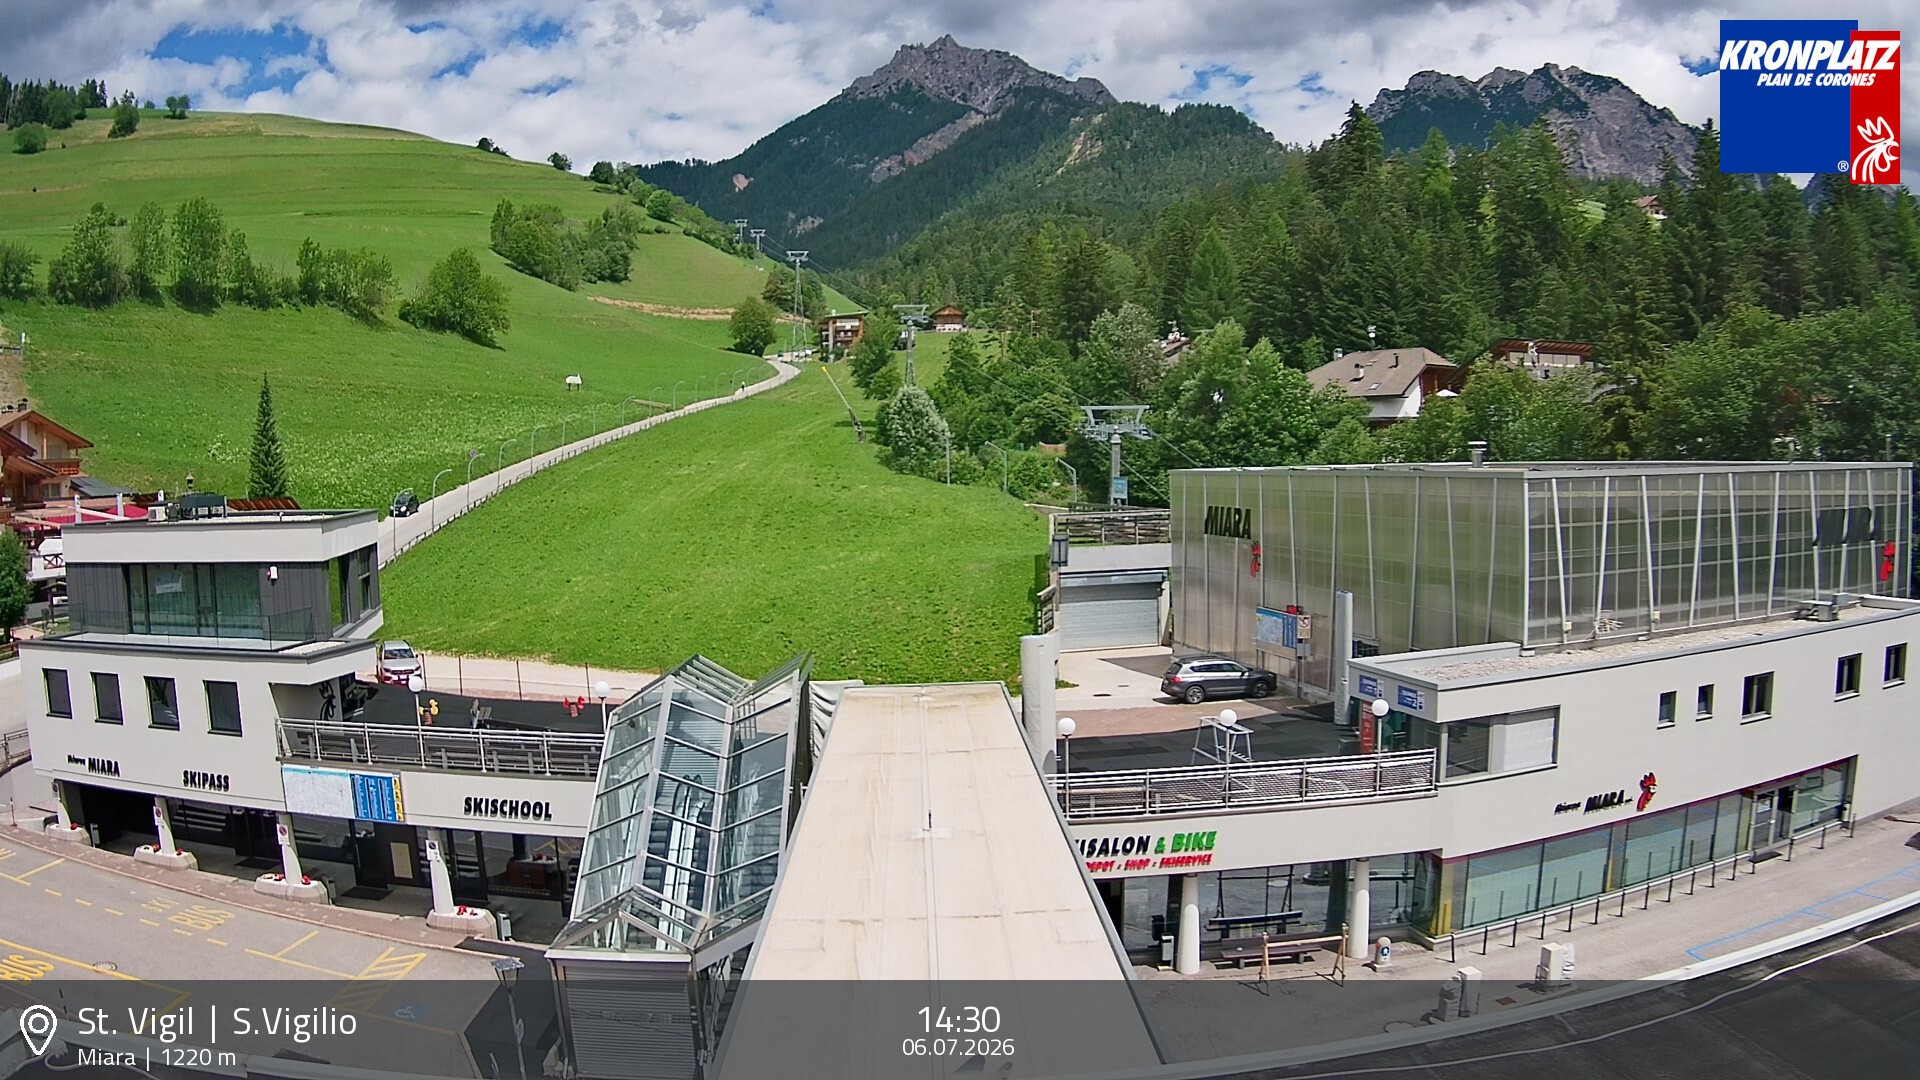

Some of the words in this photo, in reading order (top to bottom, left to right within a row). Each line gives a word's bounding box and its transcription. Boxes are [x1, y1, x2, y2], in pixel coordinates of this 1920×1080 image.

[1204, 506, 1252, 539] MIARA
[88, 757, 120, 778] MIARA
[183, 770, 230, 792] SKIPASS
[464, 796, 553, 822] SKISCHOOL
[1075, 835, 1151, 858] ISALON
[1154, 836, 1167, 854] &
[1171, 831, 1218, 854] BIKE
[168, 905, 236, 931] BUS
